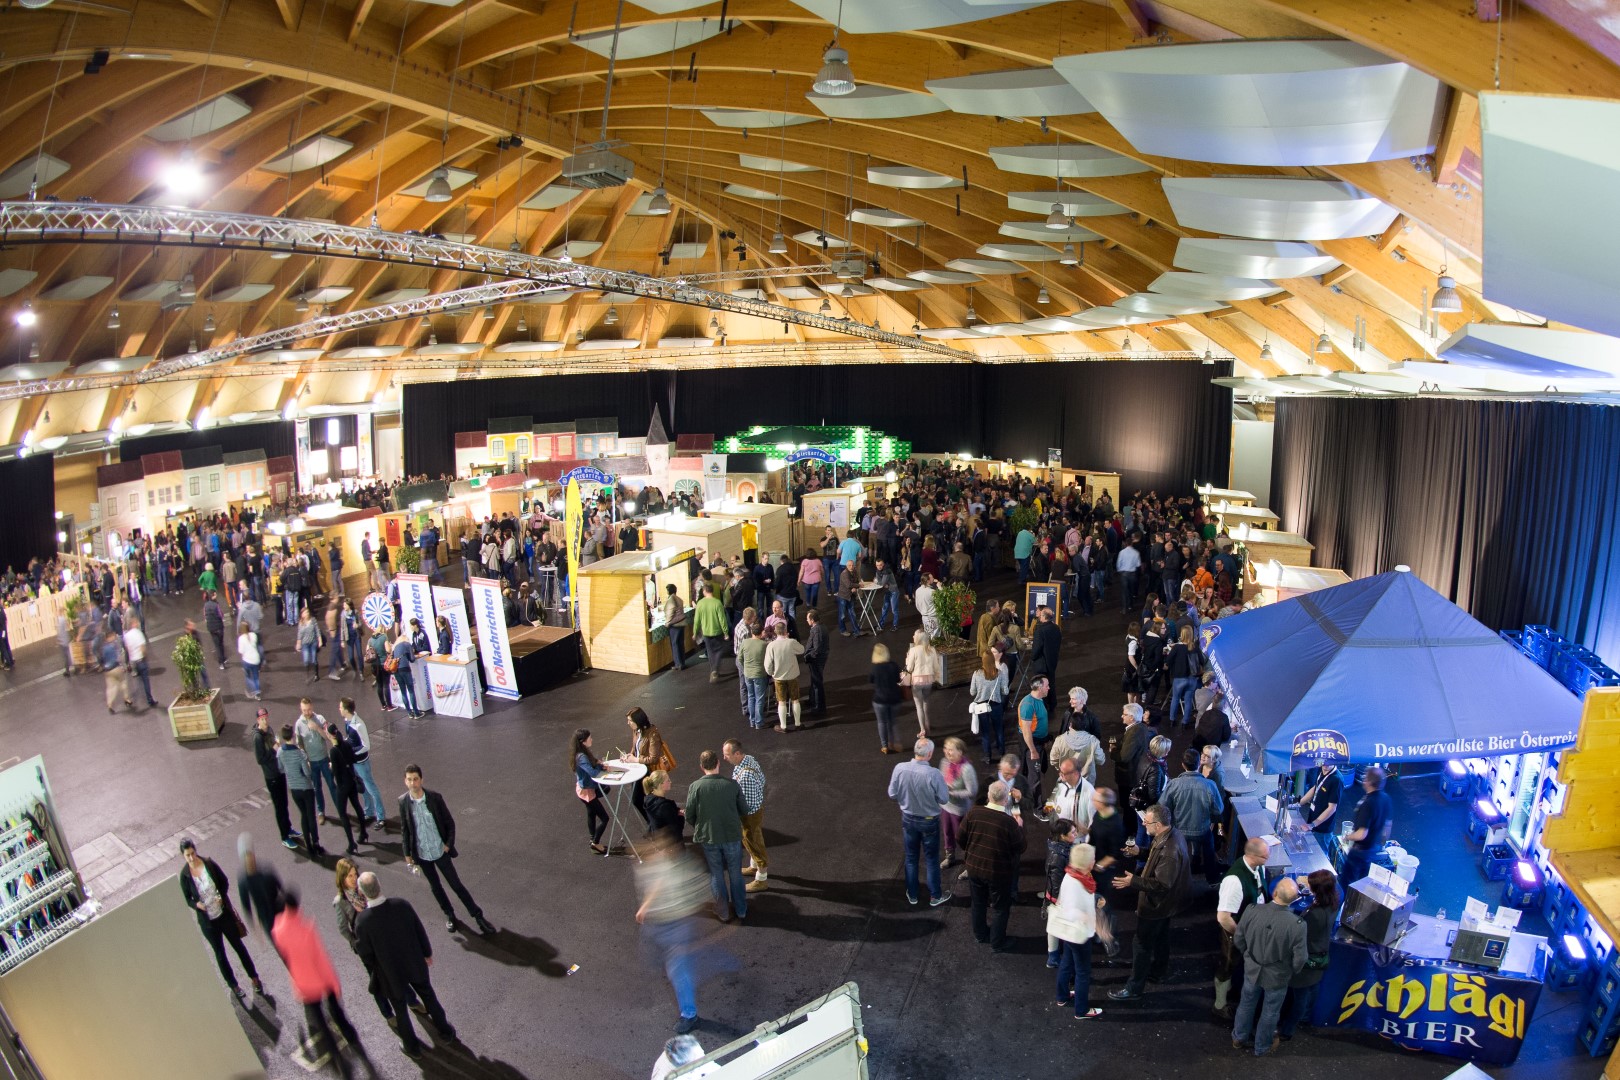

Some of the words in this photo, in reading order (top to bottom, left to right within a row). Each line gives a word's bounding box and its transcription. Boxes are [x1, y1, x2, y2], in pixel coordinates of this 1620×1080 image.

[484, 588, 507, 686] OÖNachrichten
[1374, 743, 1404, 758] Das
[1407, 738, 1484, 756] wertvollste
[1488, 735, 1517, 751] Bier
[1520, 730, 1578, 748] Österreic
[1381, 1017, 1484, 1049] BIER
